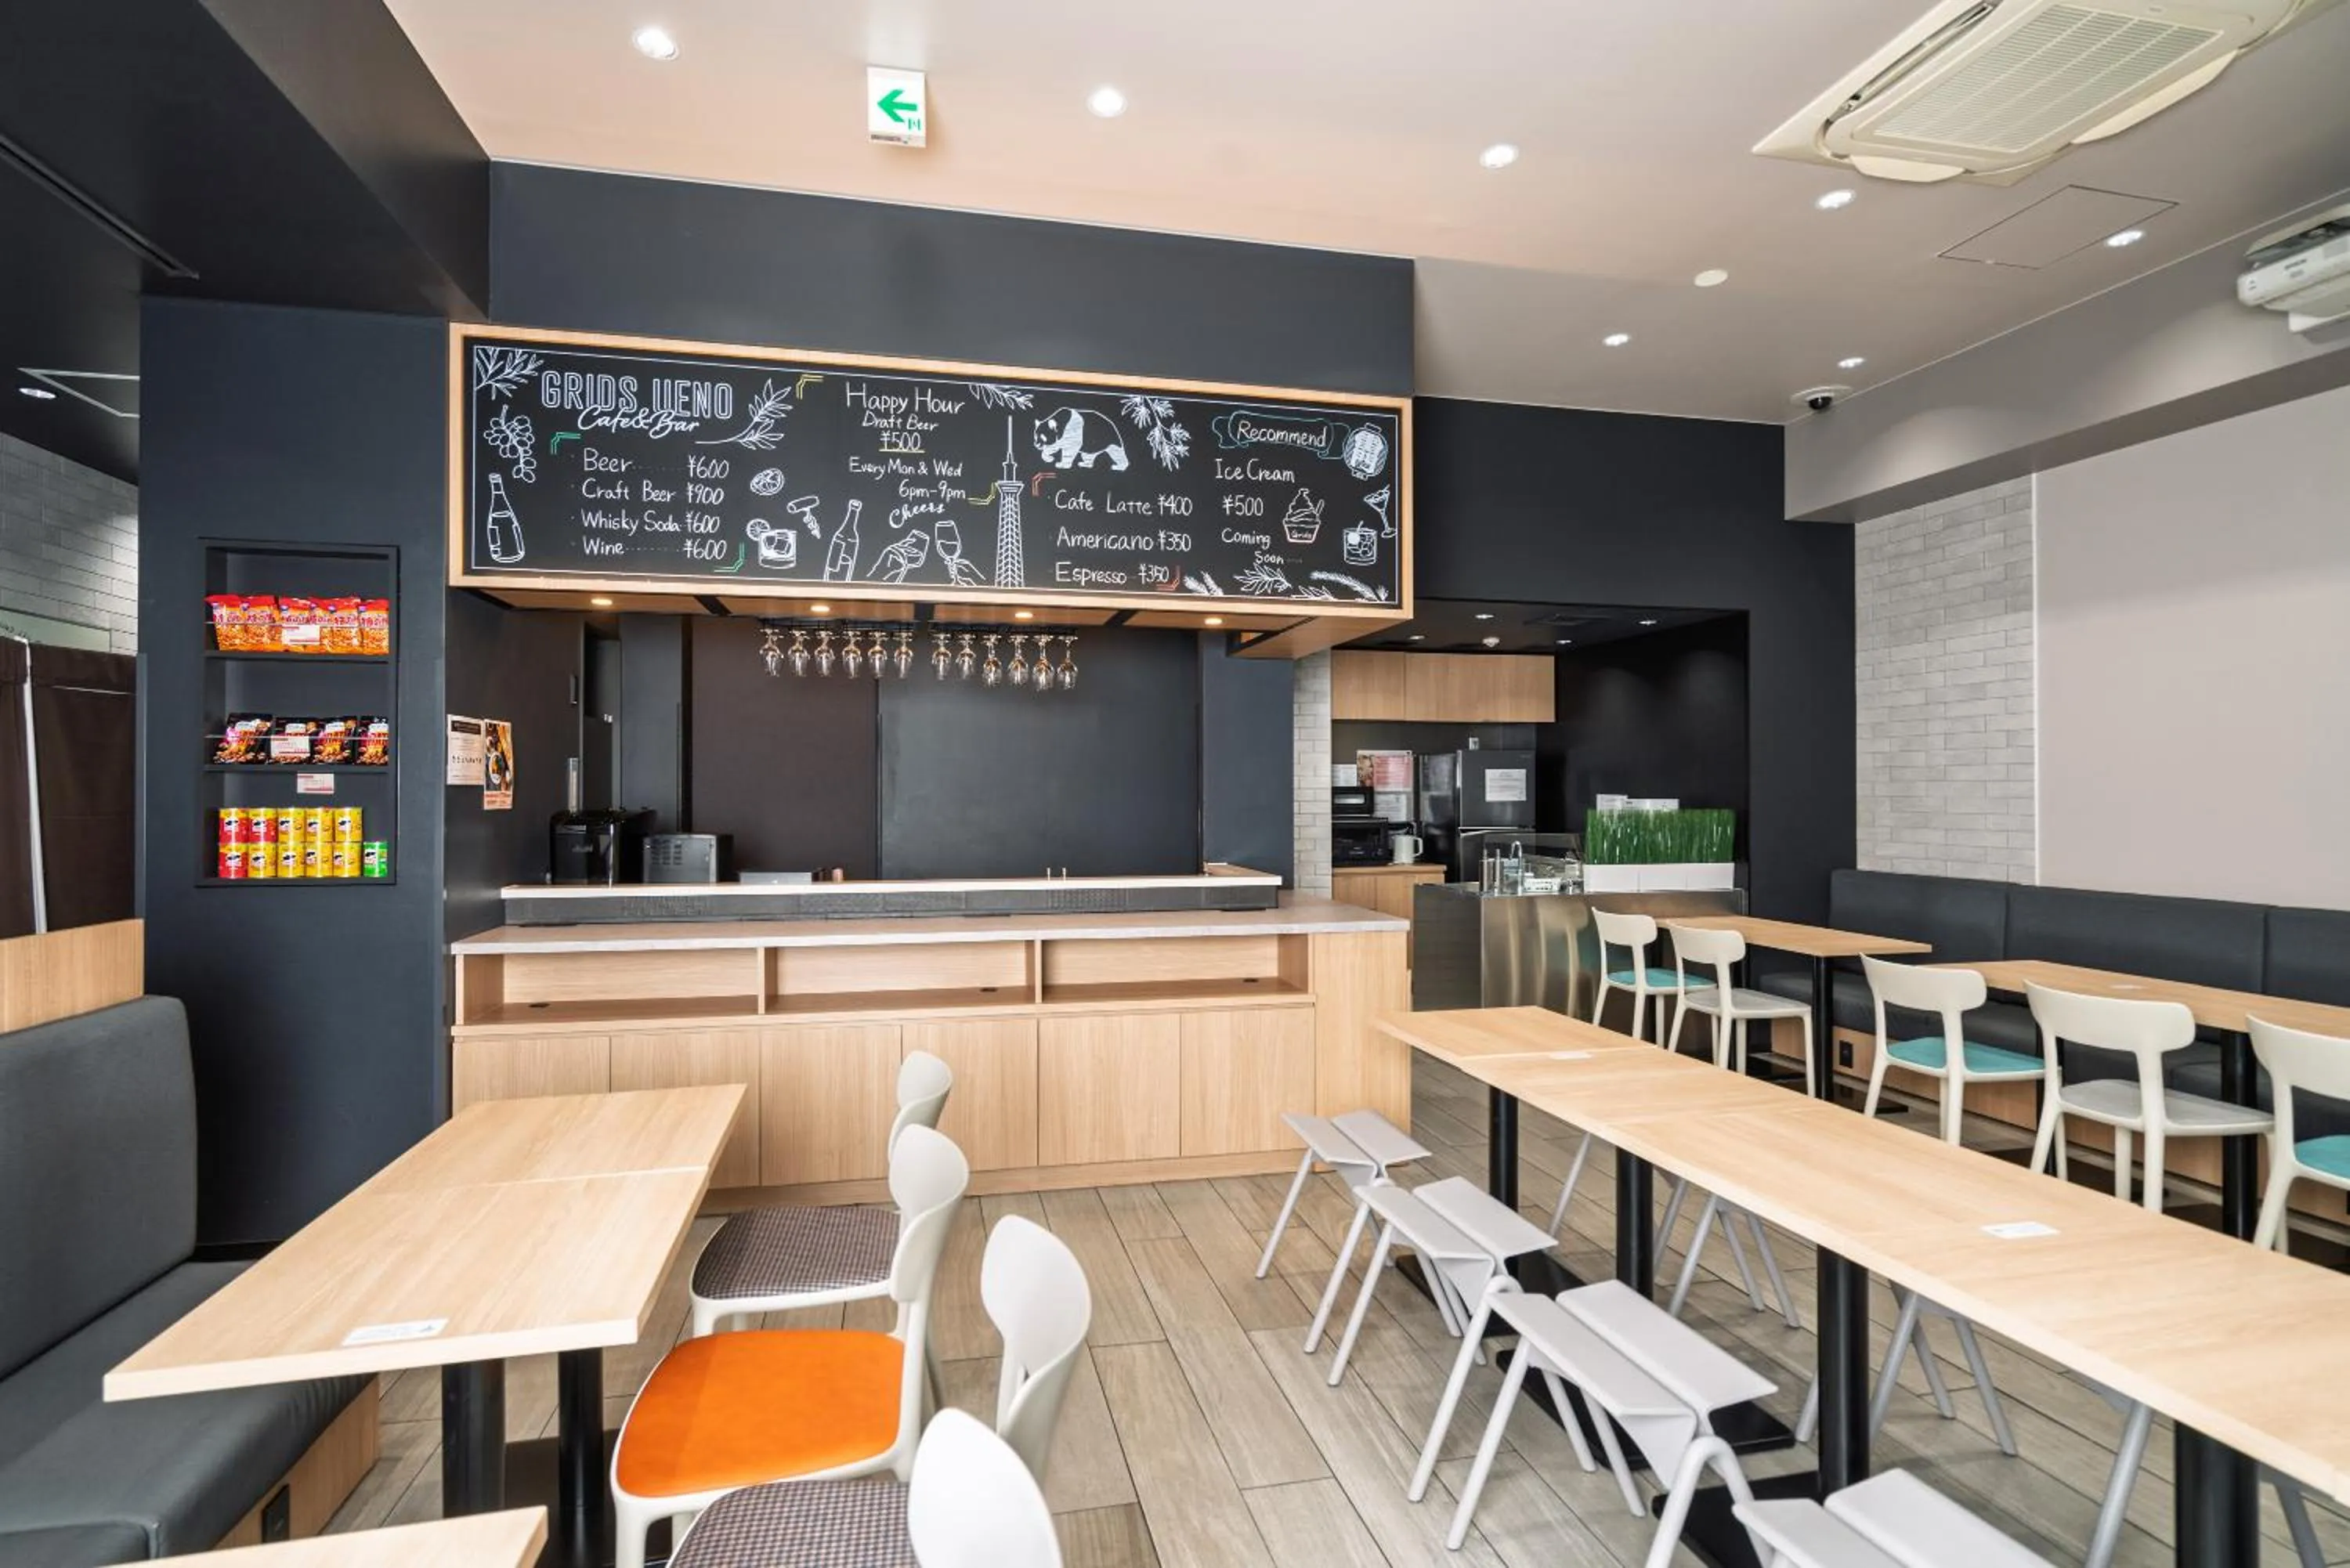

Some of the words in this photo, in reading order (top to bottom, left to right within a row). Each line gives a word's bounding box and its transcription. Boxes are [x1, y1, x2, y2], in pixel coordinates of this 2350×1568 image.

[541, 370, 638, 413] GRIDS
[653, 378, 732, 419] UENO
[846, 381, 909, 414] Happy
[915, 387, 965, 414] Hour
[862, 410, 902, 428] Draft
[906, 414, 939, 431] Beer
[880, 431, 921, 451] ¥500
[1237, 420, 1329, 447] Recommend
[584, 447, 633, 472] Beer
[688, 454, 729, 479] ¥600
[849, 456, 885, 480] Every
[888, 457, 915, 475] Mon
[917, 461, 928, 475] &
[933, 458, 963, 477] Wed
[1215, 458, 1244, 479] Ice
[1246, 458, 1295, 483] Cream
[582, 478, 630, 500] Craft
[642, 479, 676, 502] Beer
[687, 482, 725, 504] ¥900
[1055, 489, 1094, 511] Cafe
[1106, 490, 1153, 515] Latte
[1157, 493, 1193, 516] ¥400
[1222, 494, 1264, 516] ¥500
[581, 508, 639, 537] Whisky
[643, 510, 681, 532] Soda
[685, 510, 720, 533] ¥600
[583, 536, 624, 555] Wine
[683, 538, 728, 560] ¥600
[1057, 526, 1154, 551] Americano
[1157, 529, 1191, 552] ¥350
[1221, 527, 1271, 550] Coming
[1254, 551, 1285, 565] Soon
[1055, 561, 1127, 586] Espresso
[1137, 563, 1170, 585] ¥350
